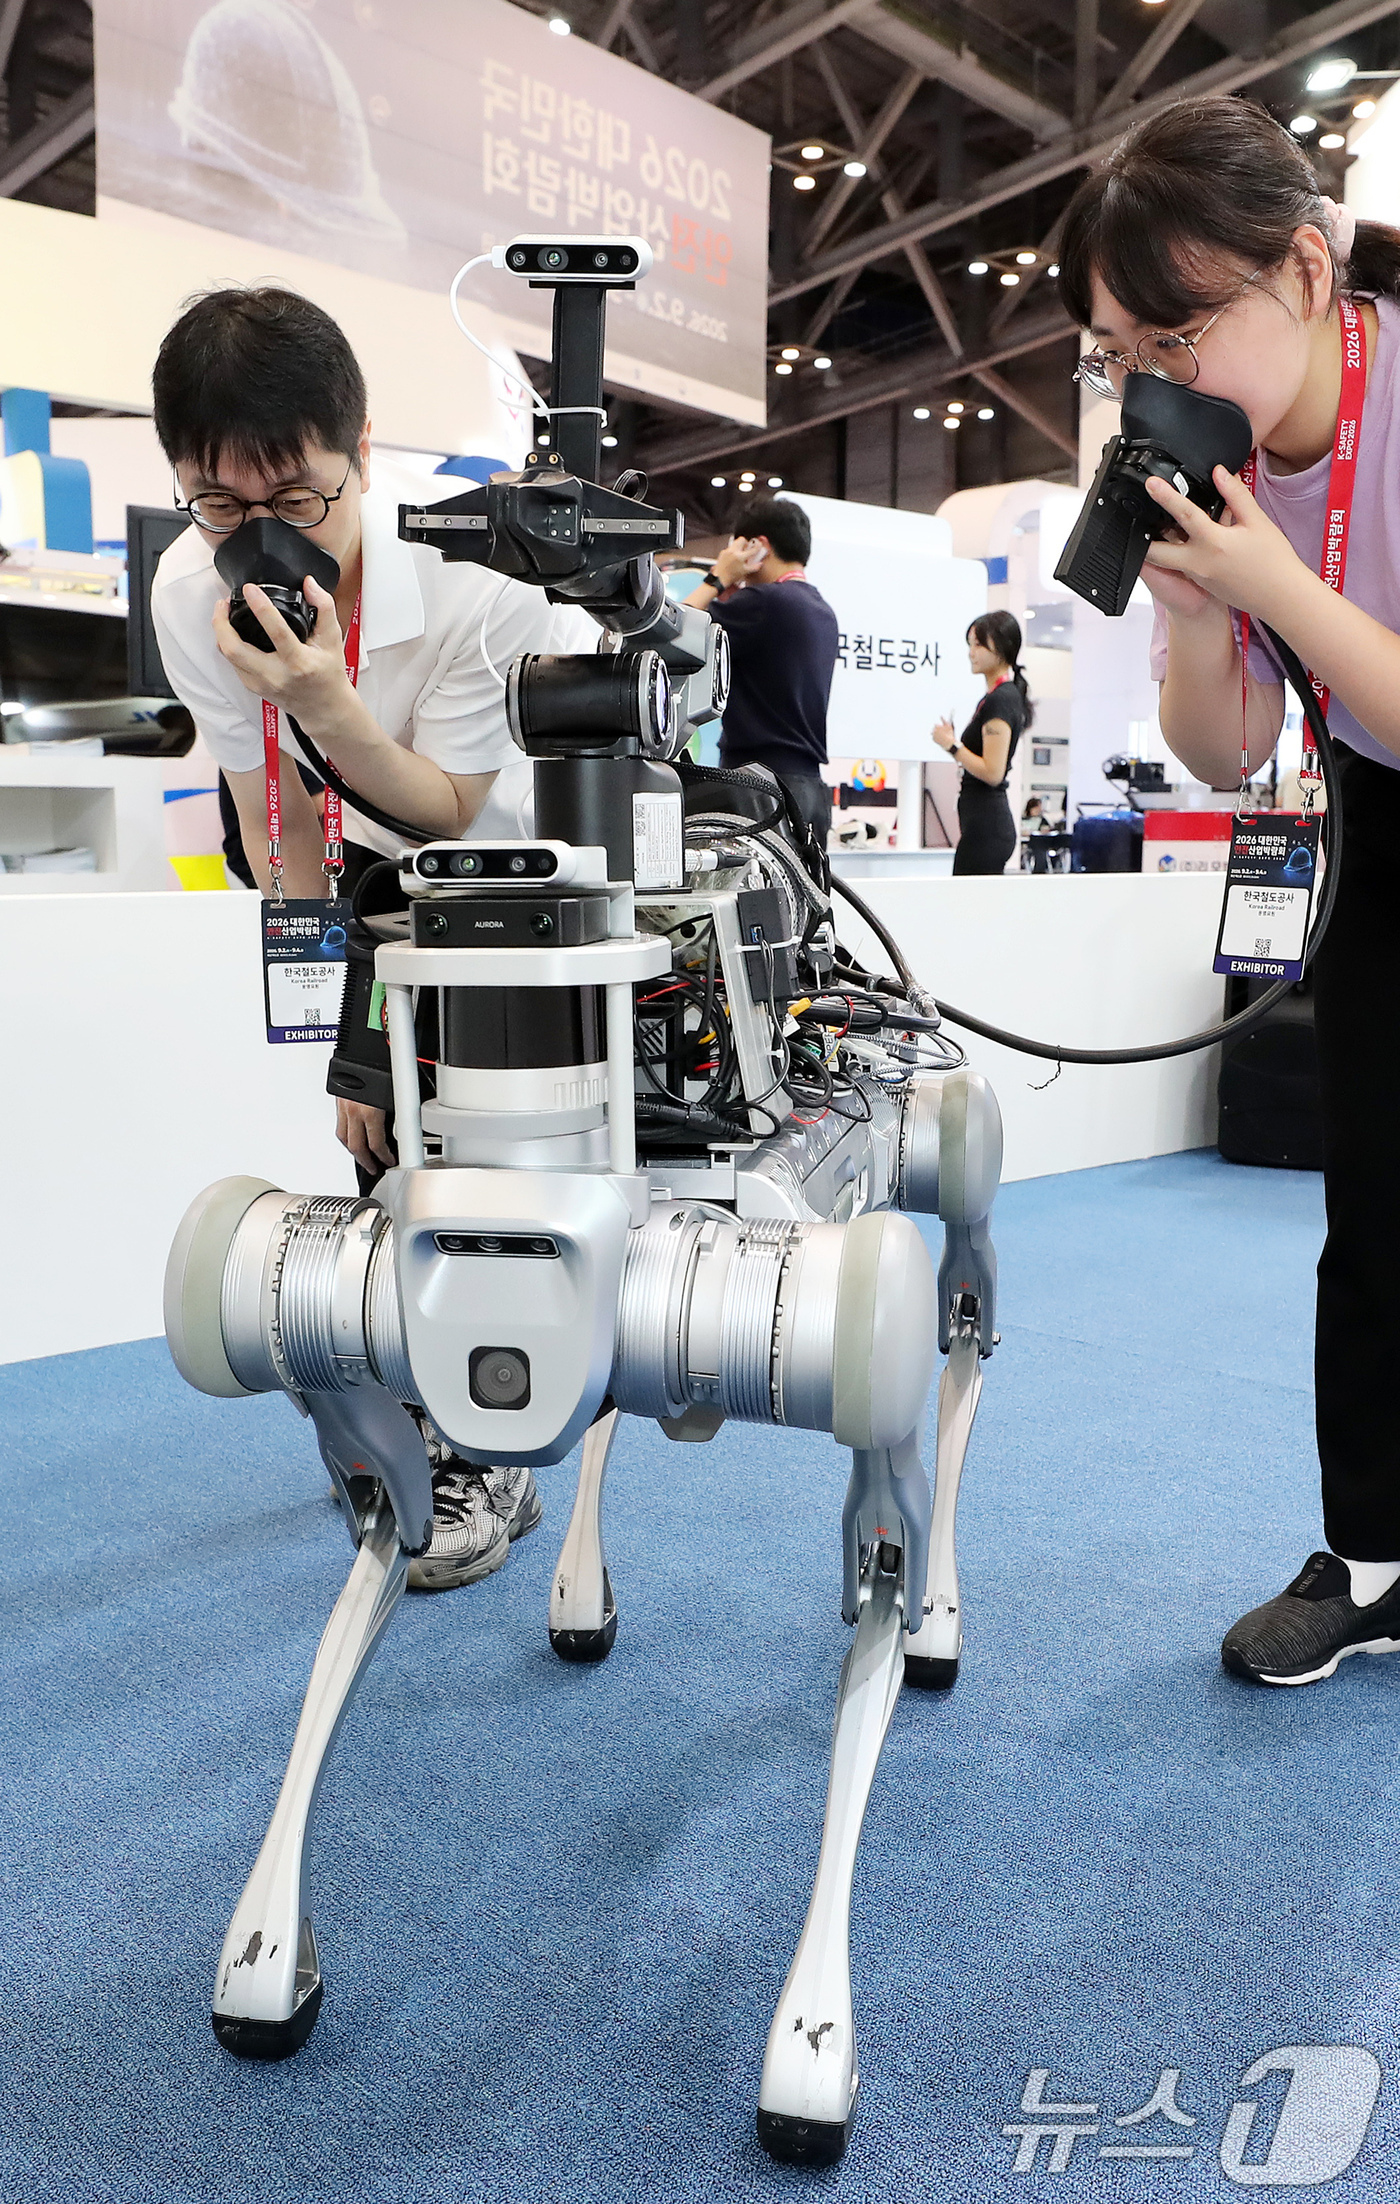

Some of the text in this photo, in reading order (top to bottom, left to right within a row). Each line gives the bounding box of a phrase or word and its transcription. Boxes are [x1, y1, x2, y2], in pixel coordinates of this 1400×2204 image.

[1341, 299, 1360, 369] 2026 대한민
[1337, 419, 1349, 460] K-SAFETY
[1345, 419, 1357, 460] EXPO 2026
[1324, 509, 1346, 588] 전산업박람회
[837, 633, 941, 676] 국철도공사
[269, 779, 278, 811] 2026
[1235, 835, 1287, 846] 2026 대한민국
[1244, 891, 1294, 904] 한국철도공사
[267, 917, 320, 927] 2026 대한민국
[474, 920, 505, 929] AURORA
[284, 966, 336, 977] 한국철도공사
[1230, 961, 1285, 976] EXHIBITOR
[284, 1029, 339, 1041] EXHIBITOR
